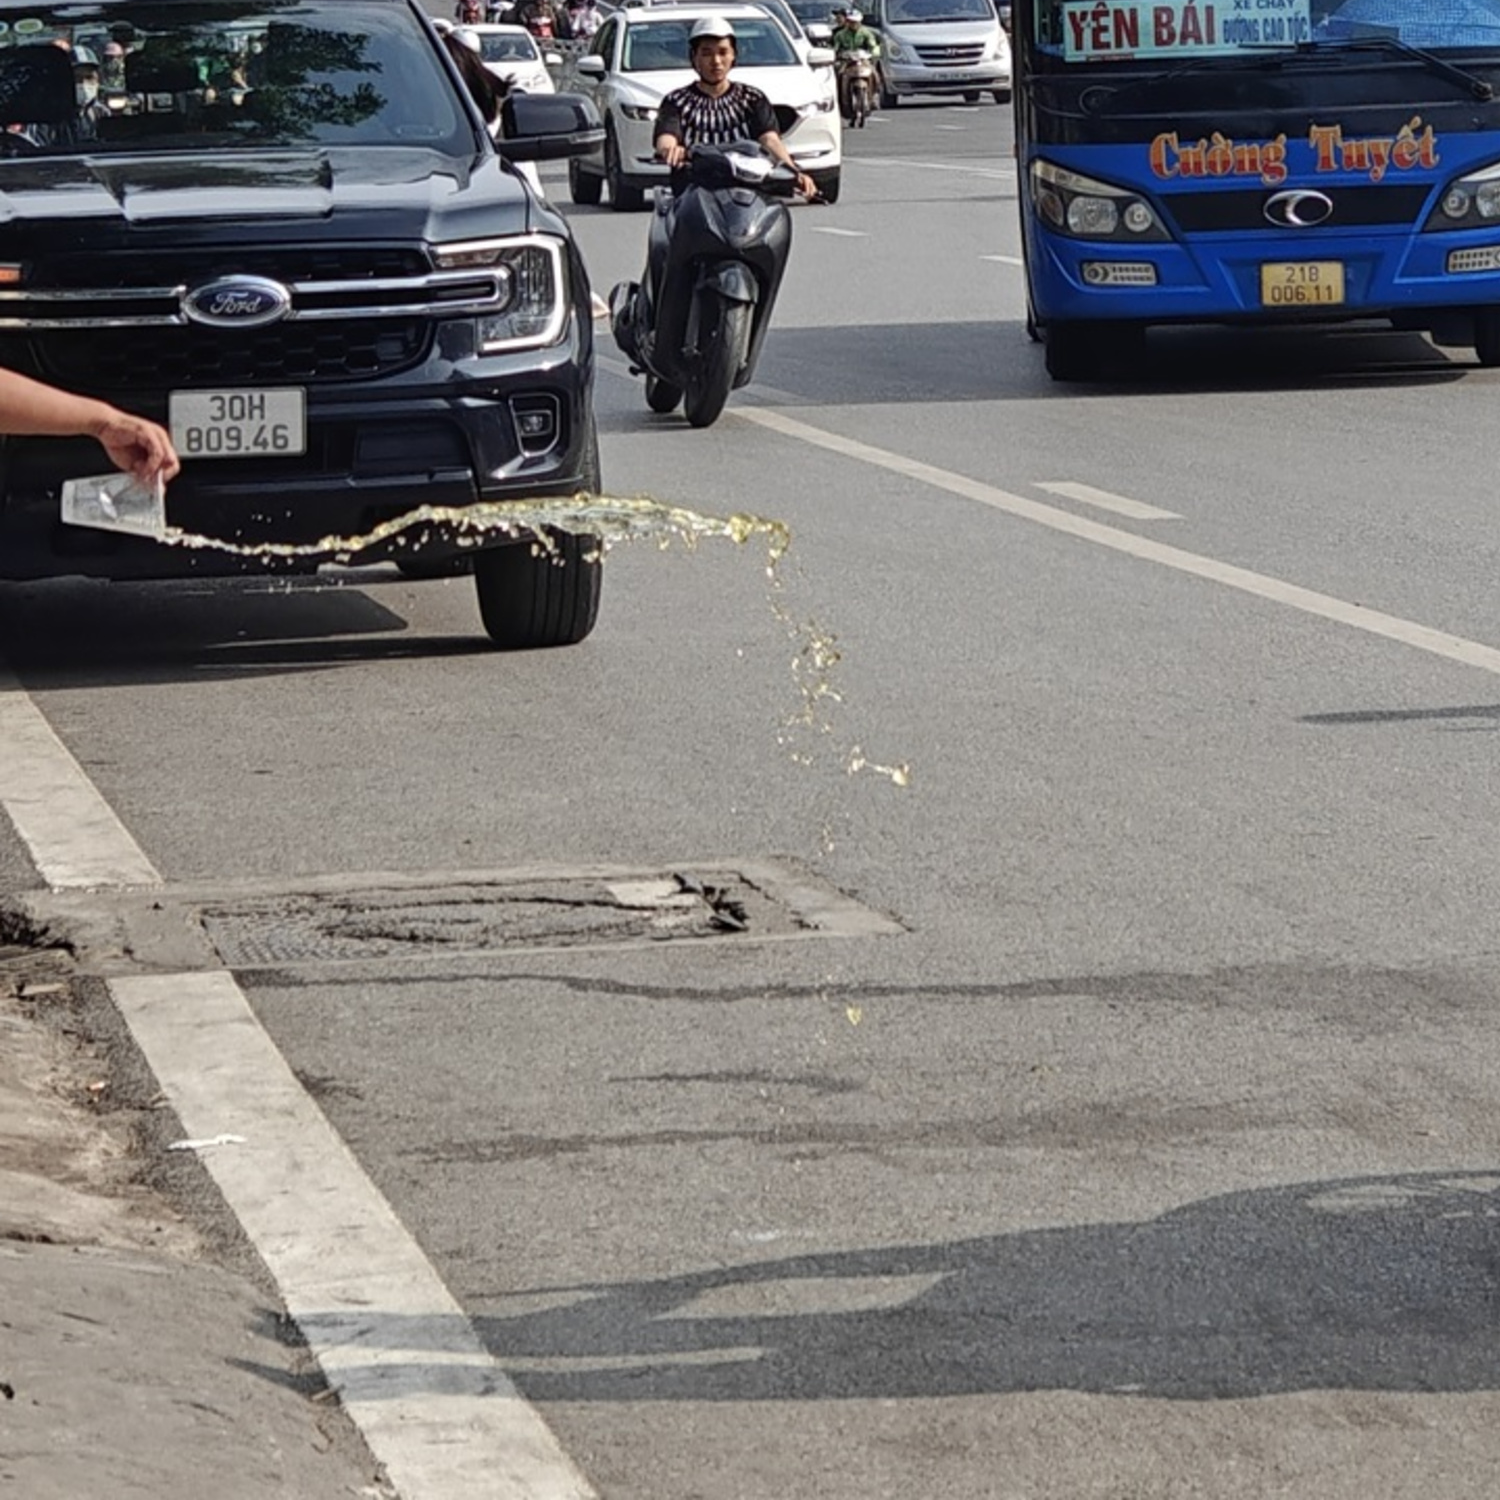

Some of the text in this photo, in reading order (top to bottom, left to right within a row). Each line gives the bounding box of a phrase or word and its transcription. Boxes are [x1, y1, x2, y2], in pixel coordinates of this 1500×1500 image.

[1067, 1, 1140, 51] YÊN
[1223, 9, 1308, 44] ĐƯỜNG CAO TỐC
[1150, 116, 1439, 185] Cường Tuyết
[1286, 265, 1320, 283] 21B
[210, 291, 262, 315] Ford
[1270, 284, 1335, 303] 006.11
[209, 393, 266, 422] 30H
[185, 424, 290, 453] 809.46
